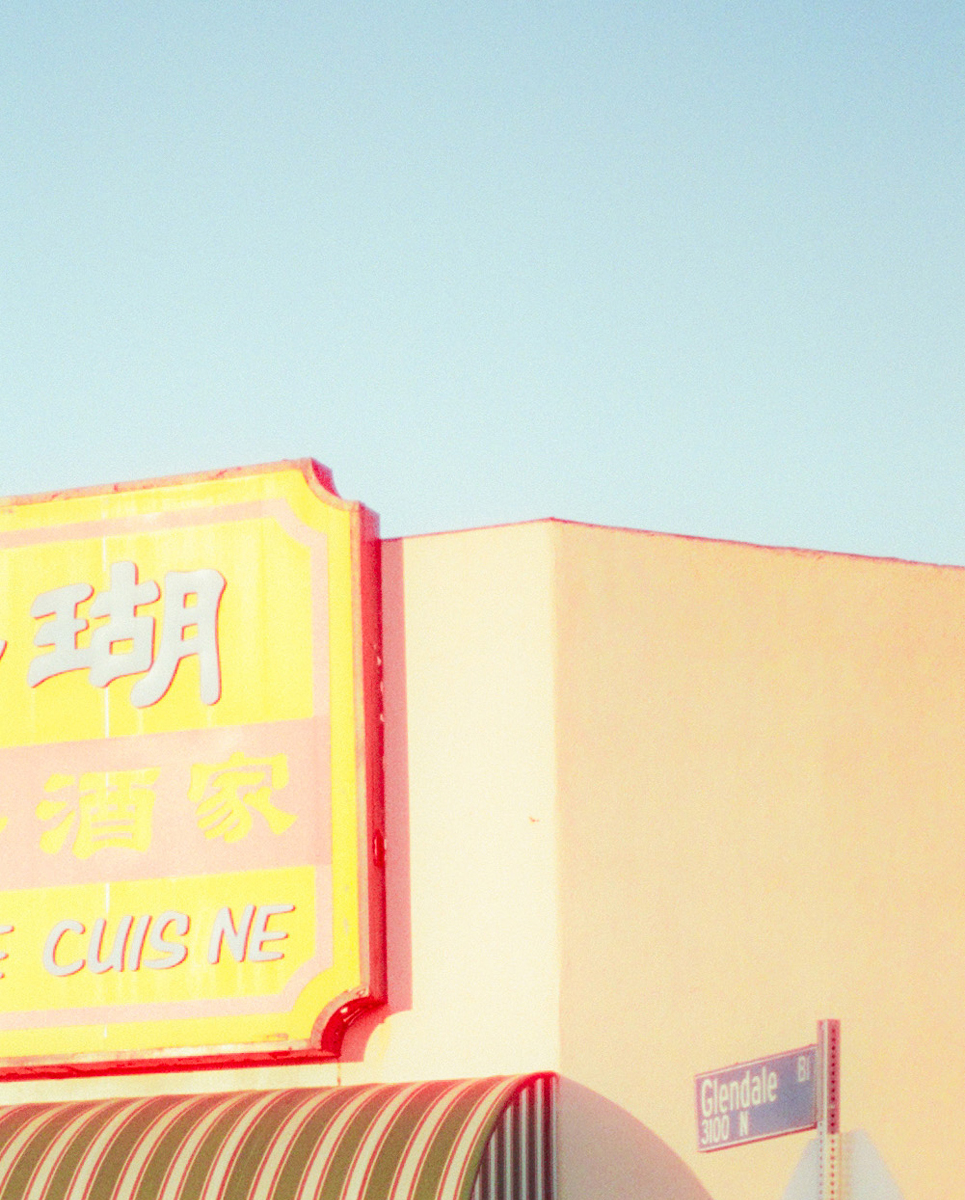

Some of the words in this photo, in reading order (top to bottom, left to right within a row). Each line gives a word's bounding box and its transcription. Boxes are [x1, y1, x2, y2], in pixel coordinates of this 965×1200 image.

[700, 1066, 778, 1118] Glendale
[700, 1114, 730, 1145] 3100
[739, 1111, 750, 1137] N
